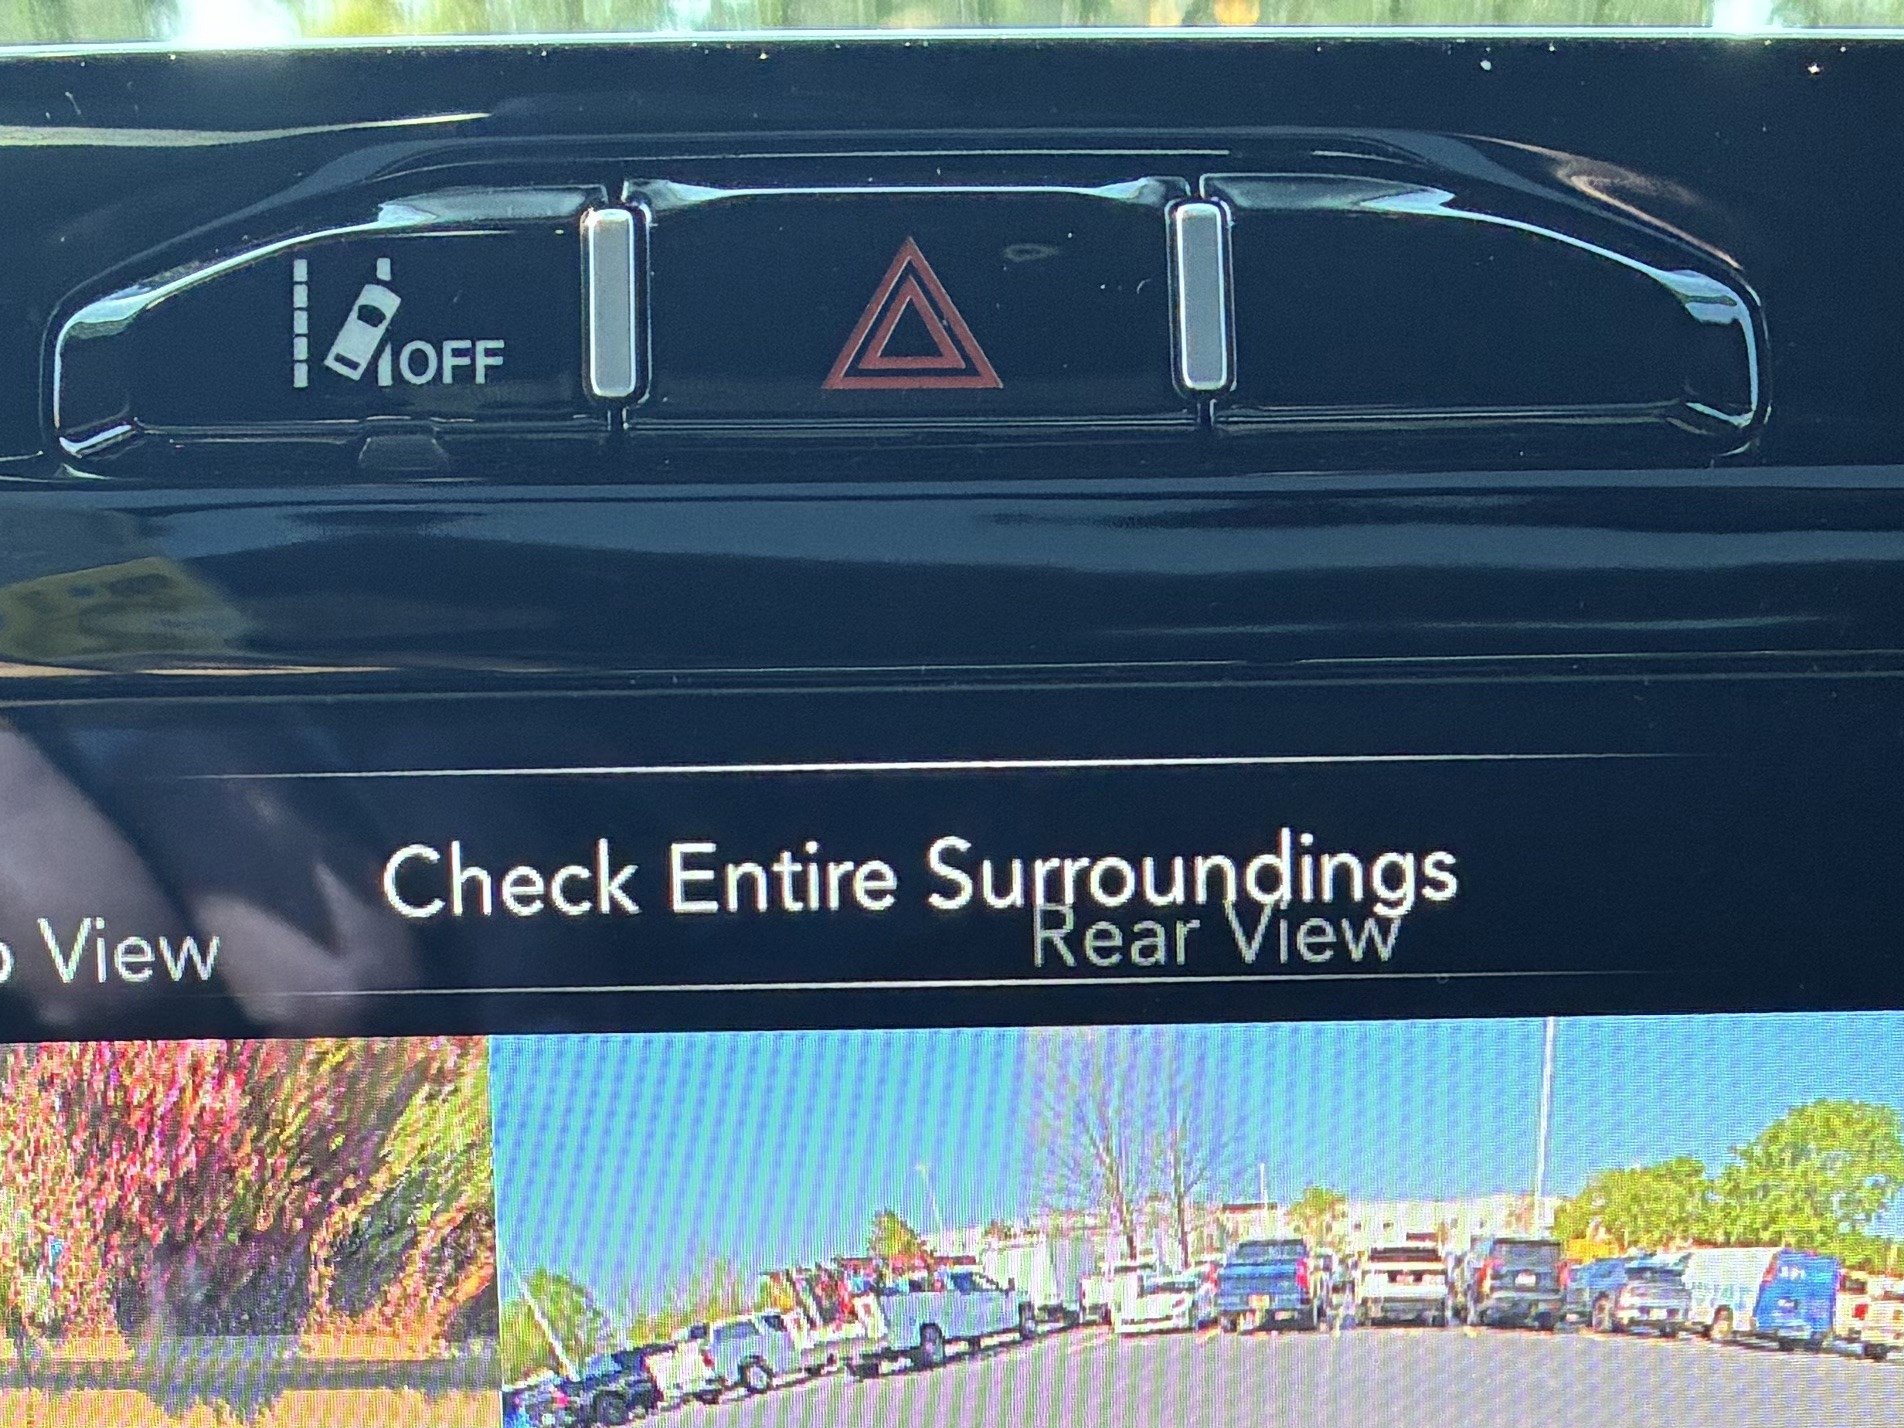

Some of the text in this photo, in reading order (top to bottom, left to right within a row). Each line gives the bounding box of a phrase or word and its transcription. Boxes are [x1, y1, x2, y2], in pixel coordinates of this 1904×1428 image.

[400, 340, 504, 384] OFF
[384, 827, 1460, 917] Check Entire Surroundings
[43, 917, 219, 983] View
[1034, 900, 1401, 966] Rear View
